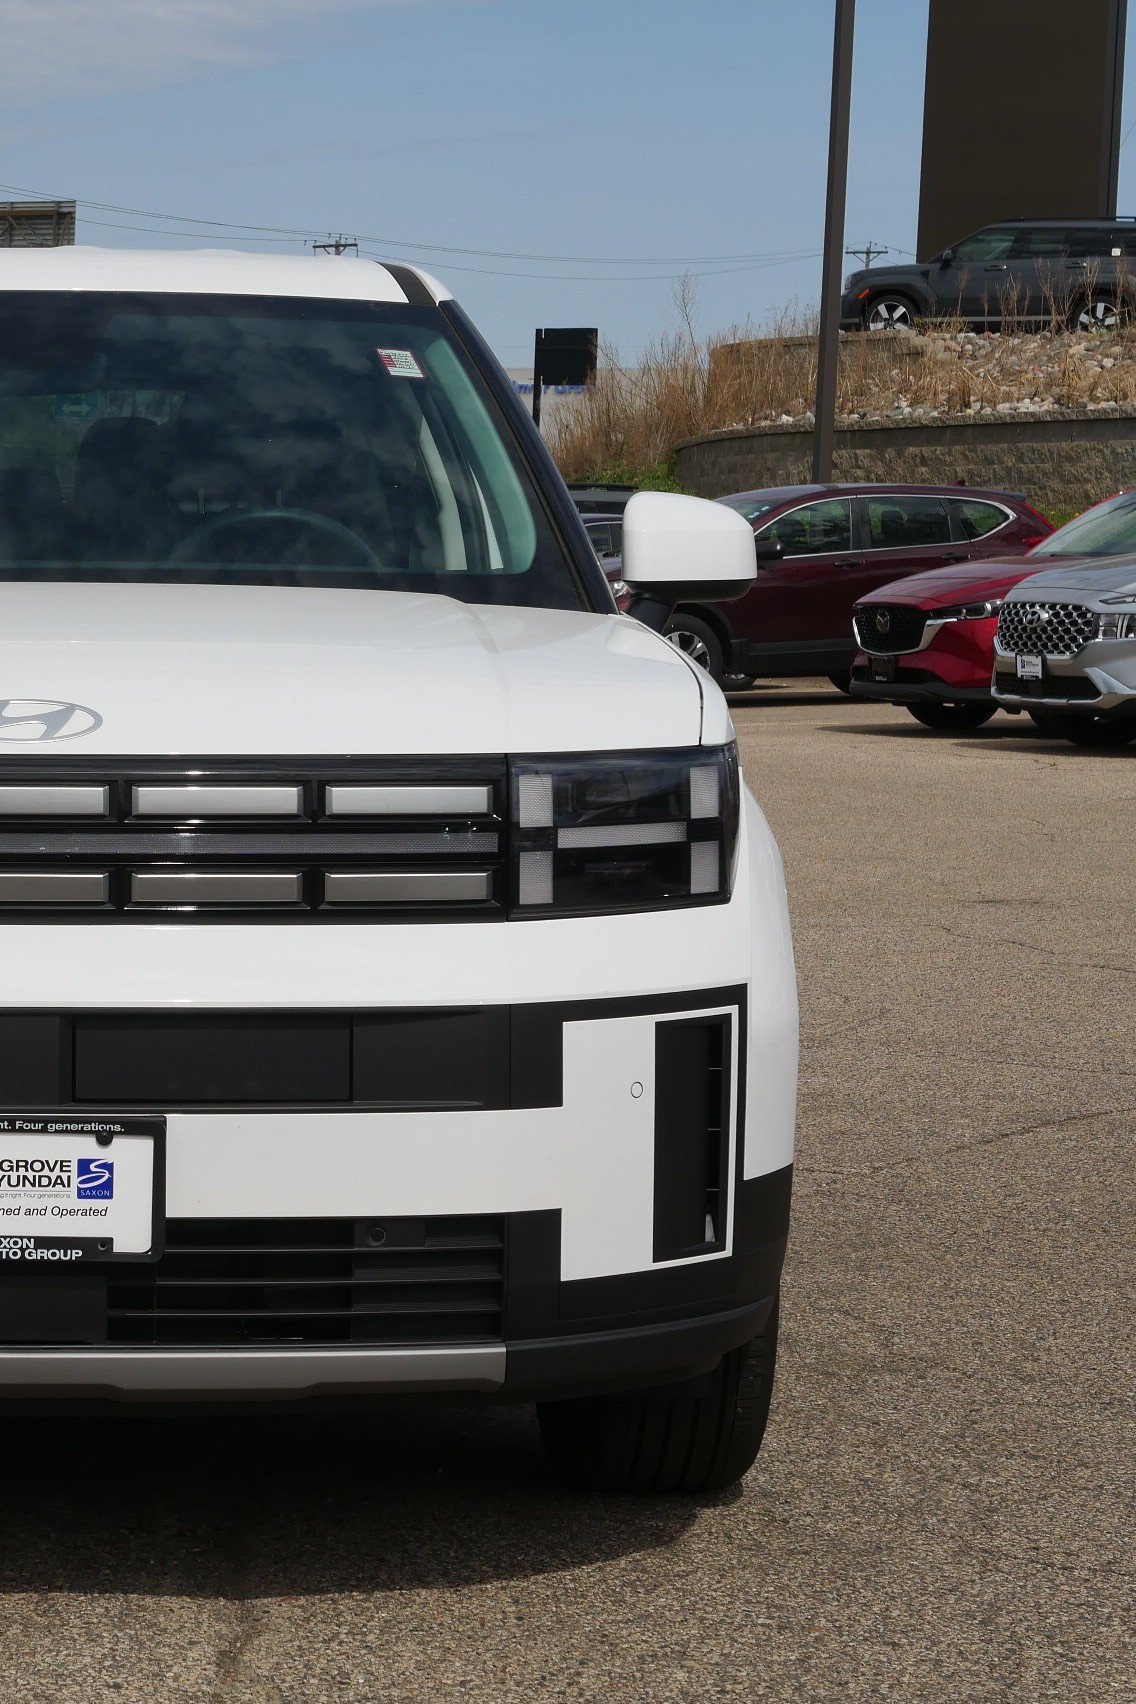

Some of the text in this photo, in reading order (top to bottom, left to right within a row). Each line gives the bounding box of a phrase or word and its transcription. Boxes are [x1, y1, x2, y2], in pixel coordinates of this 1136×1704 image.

[15, 1121, 44, 1130] Four
[47, 1122, 125, 1132] generations.
[80, 1189, 110, 1197] SAXON
[24, 1206, 48, 1216] and
[50, 1205, 109, 1218] Operated
[24, 1249, 83, 1260] GROUP
